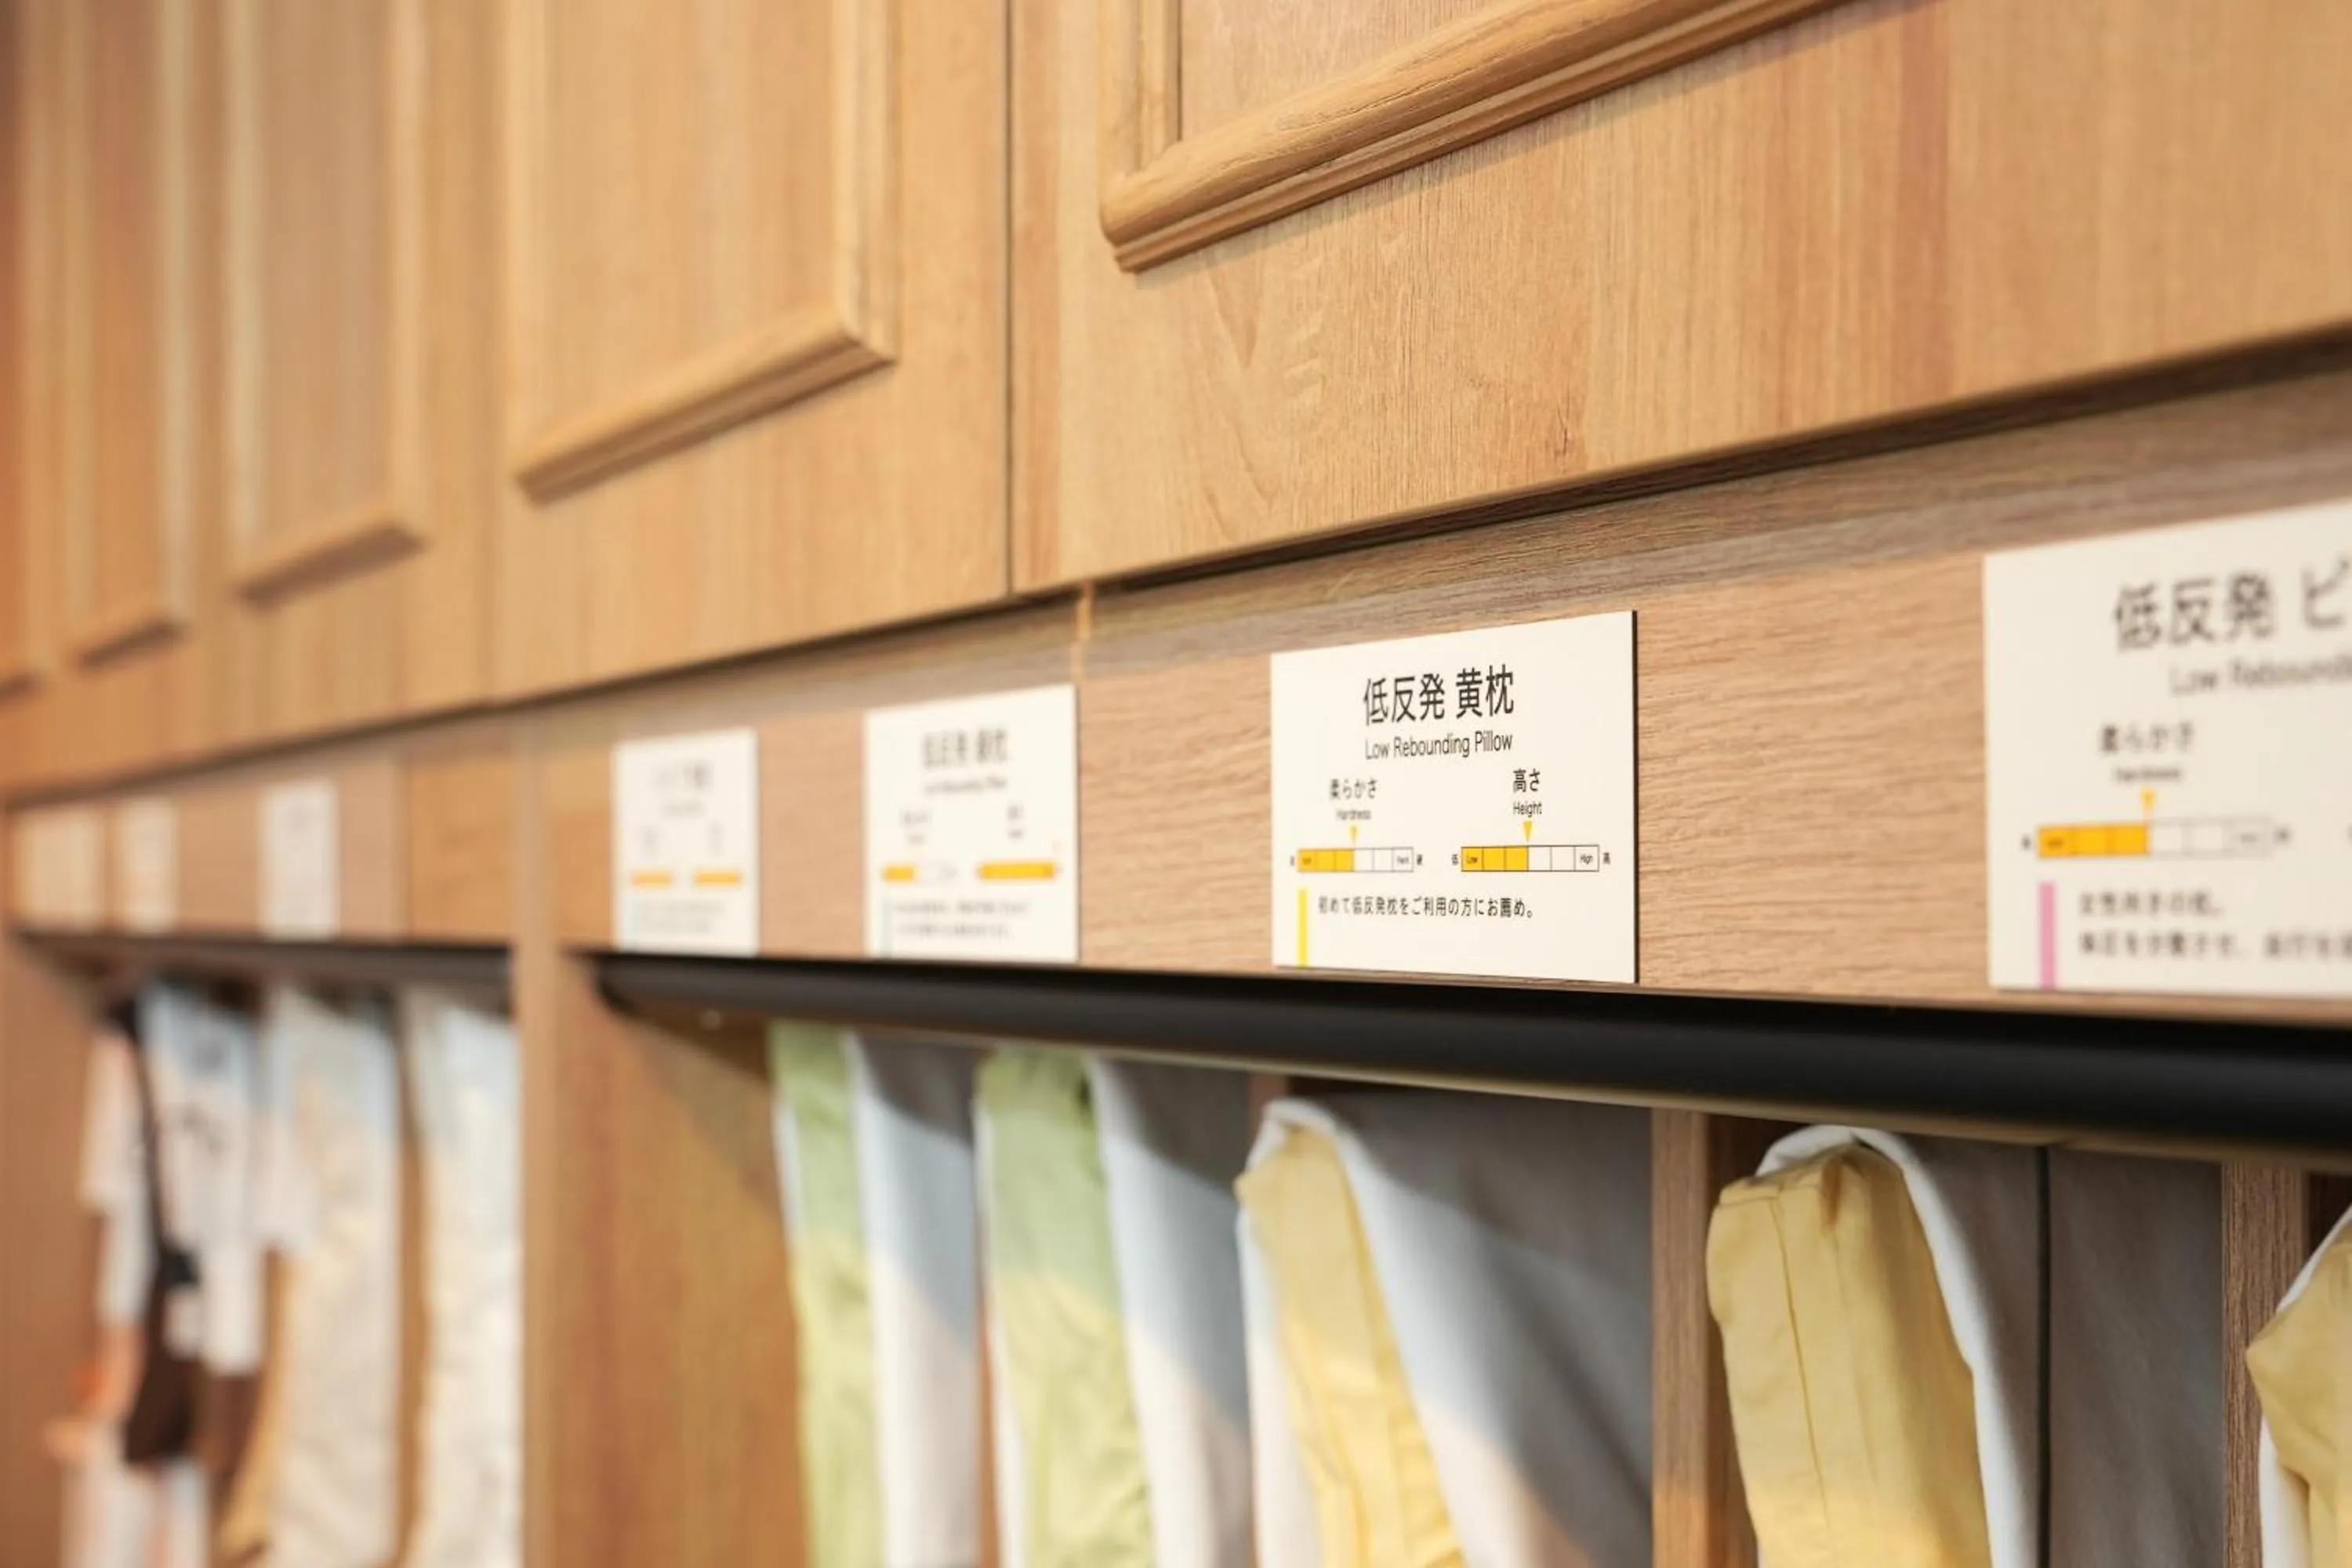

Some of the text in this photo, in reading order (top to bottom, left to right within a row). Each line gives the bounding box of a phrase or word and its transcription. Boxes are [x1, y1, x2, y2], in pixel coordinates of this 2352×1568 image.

[2114, 572, 2271, 650] 低反発
[1363, 664, 1515, 725] 低反発 黄枕
[1365, 730, 1512, 760] Low Rebounding Pillow
[1330, 778, 1377, 800] 柔らかさ
[1512, 768, 1541, 793] 高さ
[1513, 801, 1542, 818] Height
